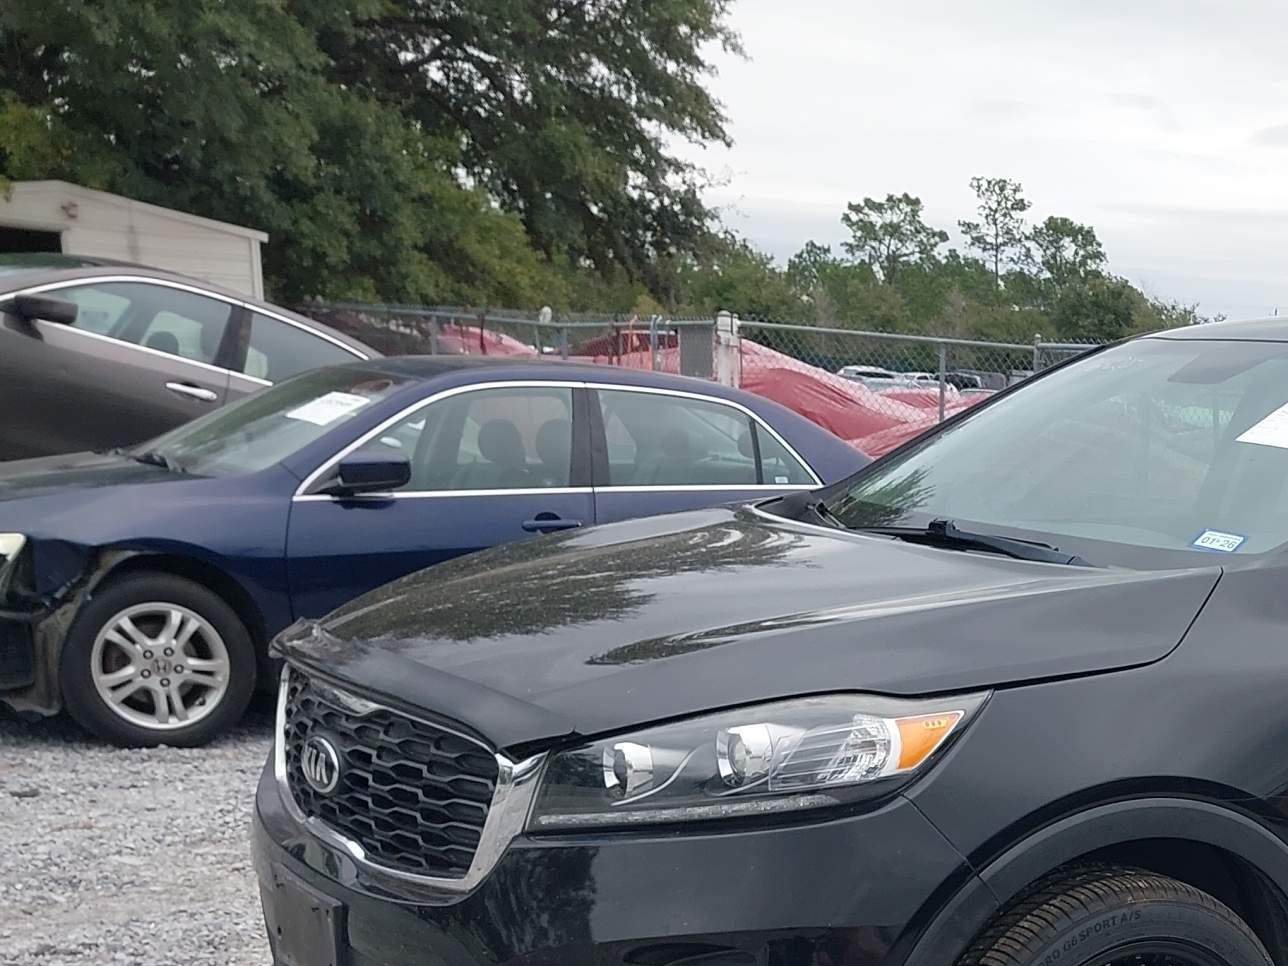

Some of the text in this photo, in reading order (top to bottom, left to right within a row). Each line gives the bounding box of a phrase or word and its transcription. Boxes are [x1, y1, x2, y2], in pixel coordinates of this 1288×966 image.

[304, 745, 328, 784] KIA
[1079, 915, 1117, 942] SPORT
[1119, 910, 1142, 924] A/S
